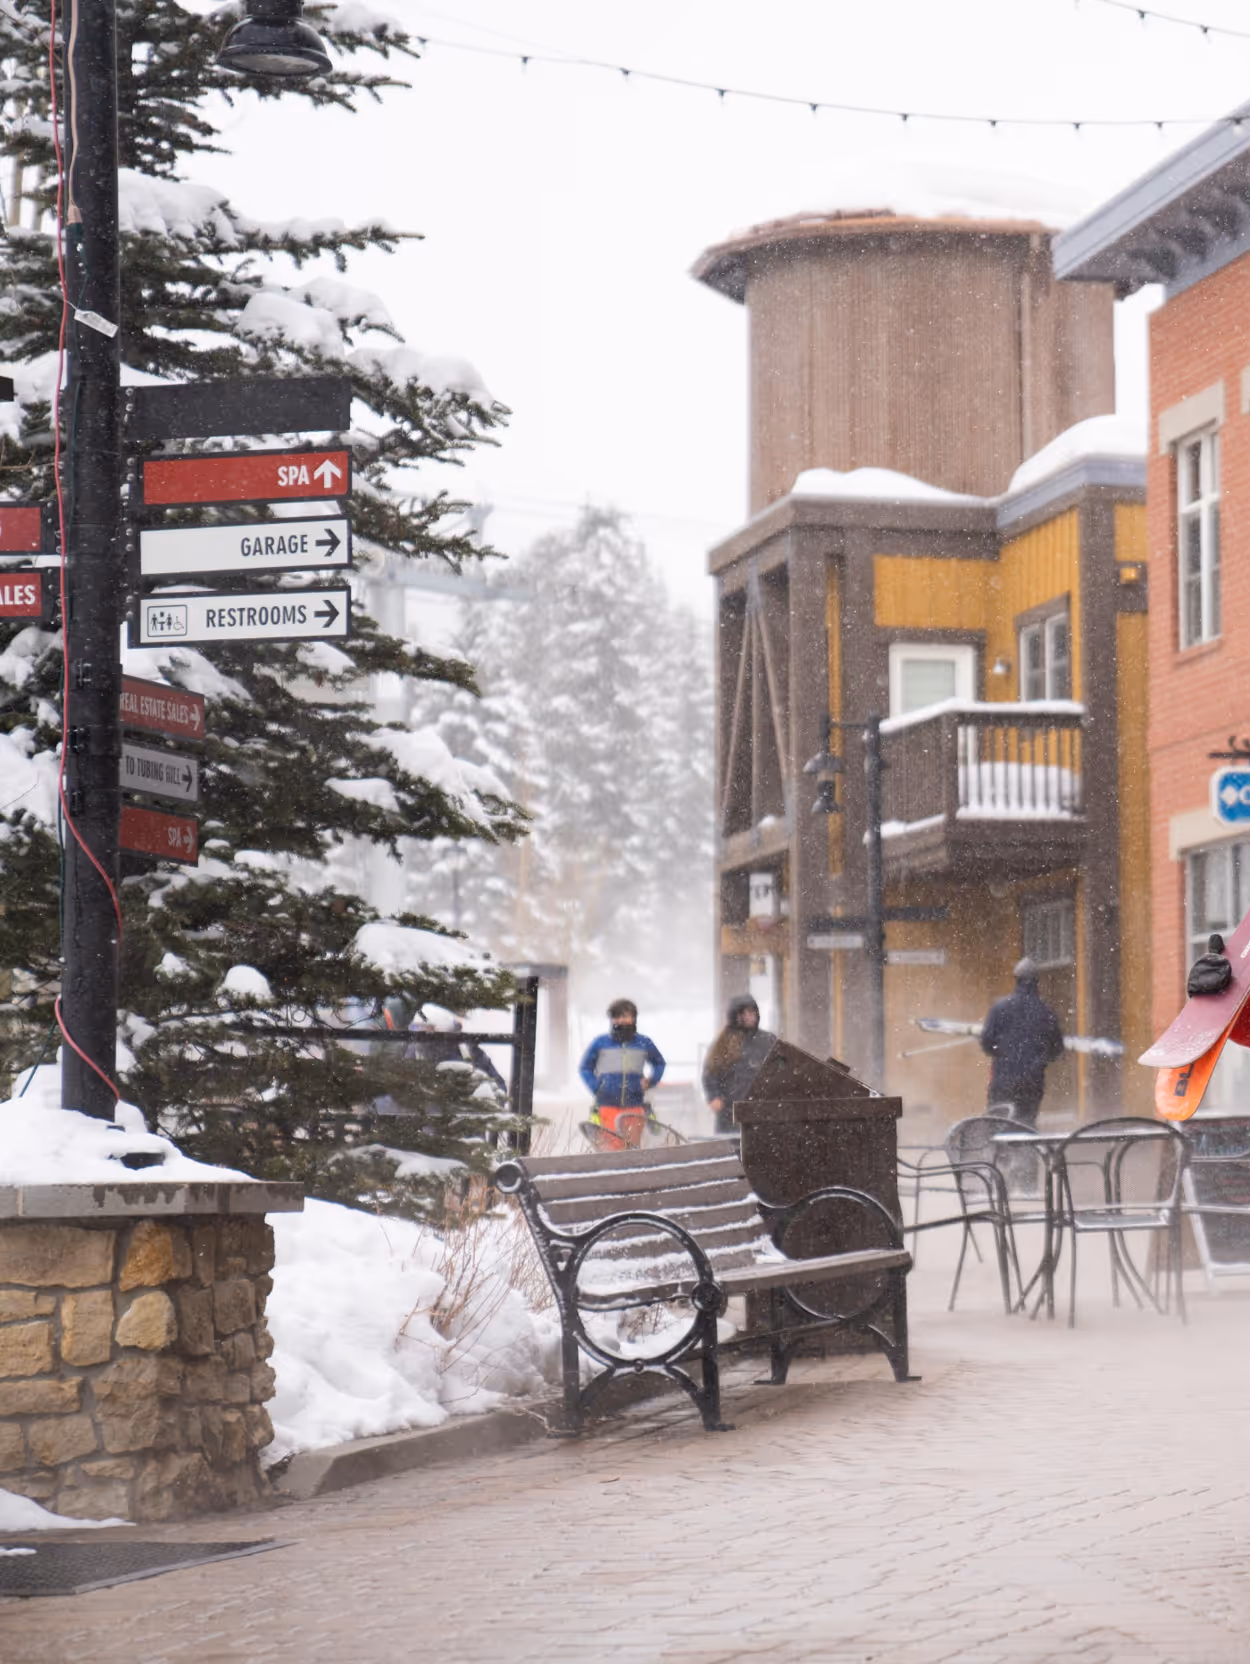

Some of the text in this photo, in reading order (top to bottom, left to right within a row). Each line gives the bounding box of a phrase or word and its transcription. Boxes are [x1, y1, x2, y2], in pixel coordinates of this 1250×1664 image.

[277, 464, 310, 487] SPA
[240, 534, 309, 557] GARAGE
[0, 584, 36, 606] LES
[206, 604, 307, 628] RESTROOMS
[120, 692, 189, 725] REAL ESTATE SALES
[126, 754, 135, 775] TO
[137, 757, 164, 783] TUBING
[167, 826, 182, 849] SPA
